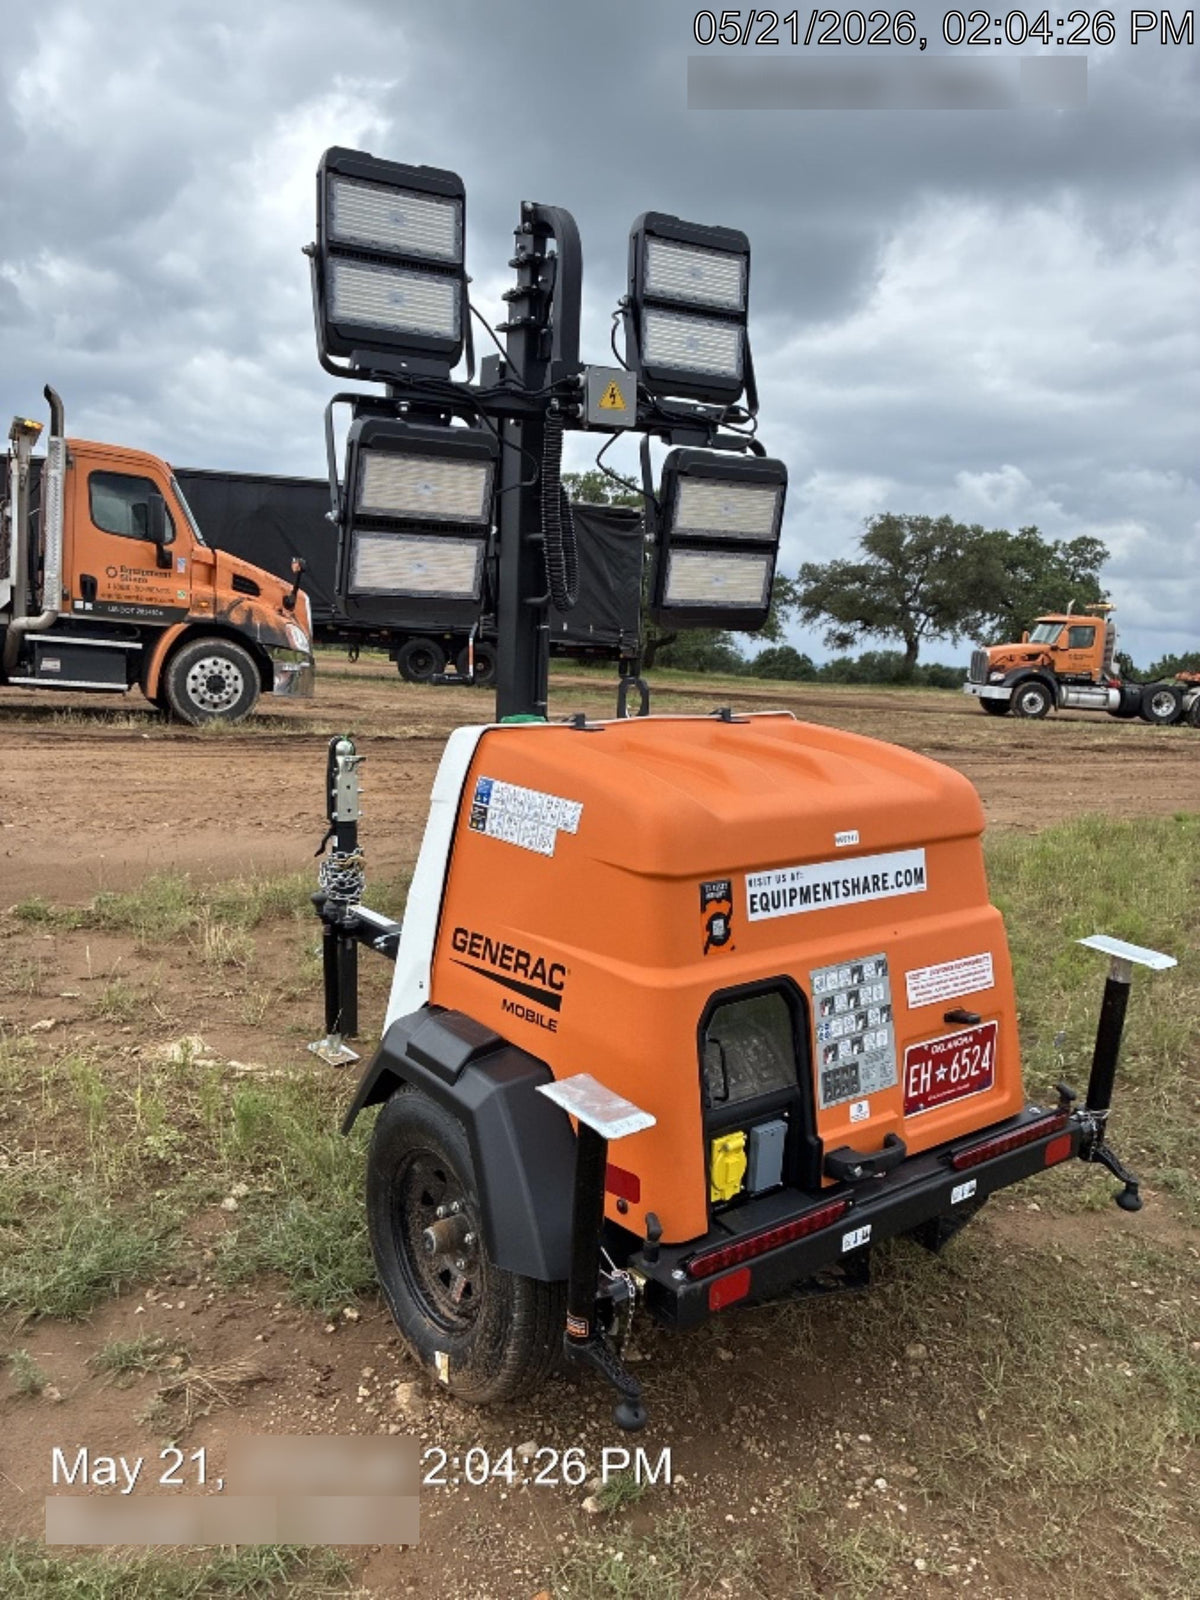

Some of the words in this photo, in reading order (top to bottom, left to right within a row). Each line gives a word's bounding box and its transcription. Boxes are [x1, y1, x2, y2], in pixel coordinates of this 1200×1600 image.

[748, 875, 773, 888] VISIT
[775, 874, 787, 885] US
[749, 866, 925, 915] EQUIPMENTSHARE.COM
[452, 926, 567, 992] GENERAC
[501, 998, 558, 1034] MOBILE
[931, 1034, 974, 1055] OKLAHOMA
[908, 1059, 933, 1098] EH
[950, 1040, 992, 1084] 6524
